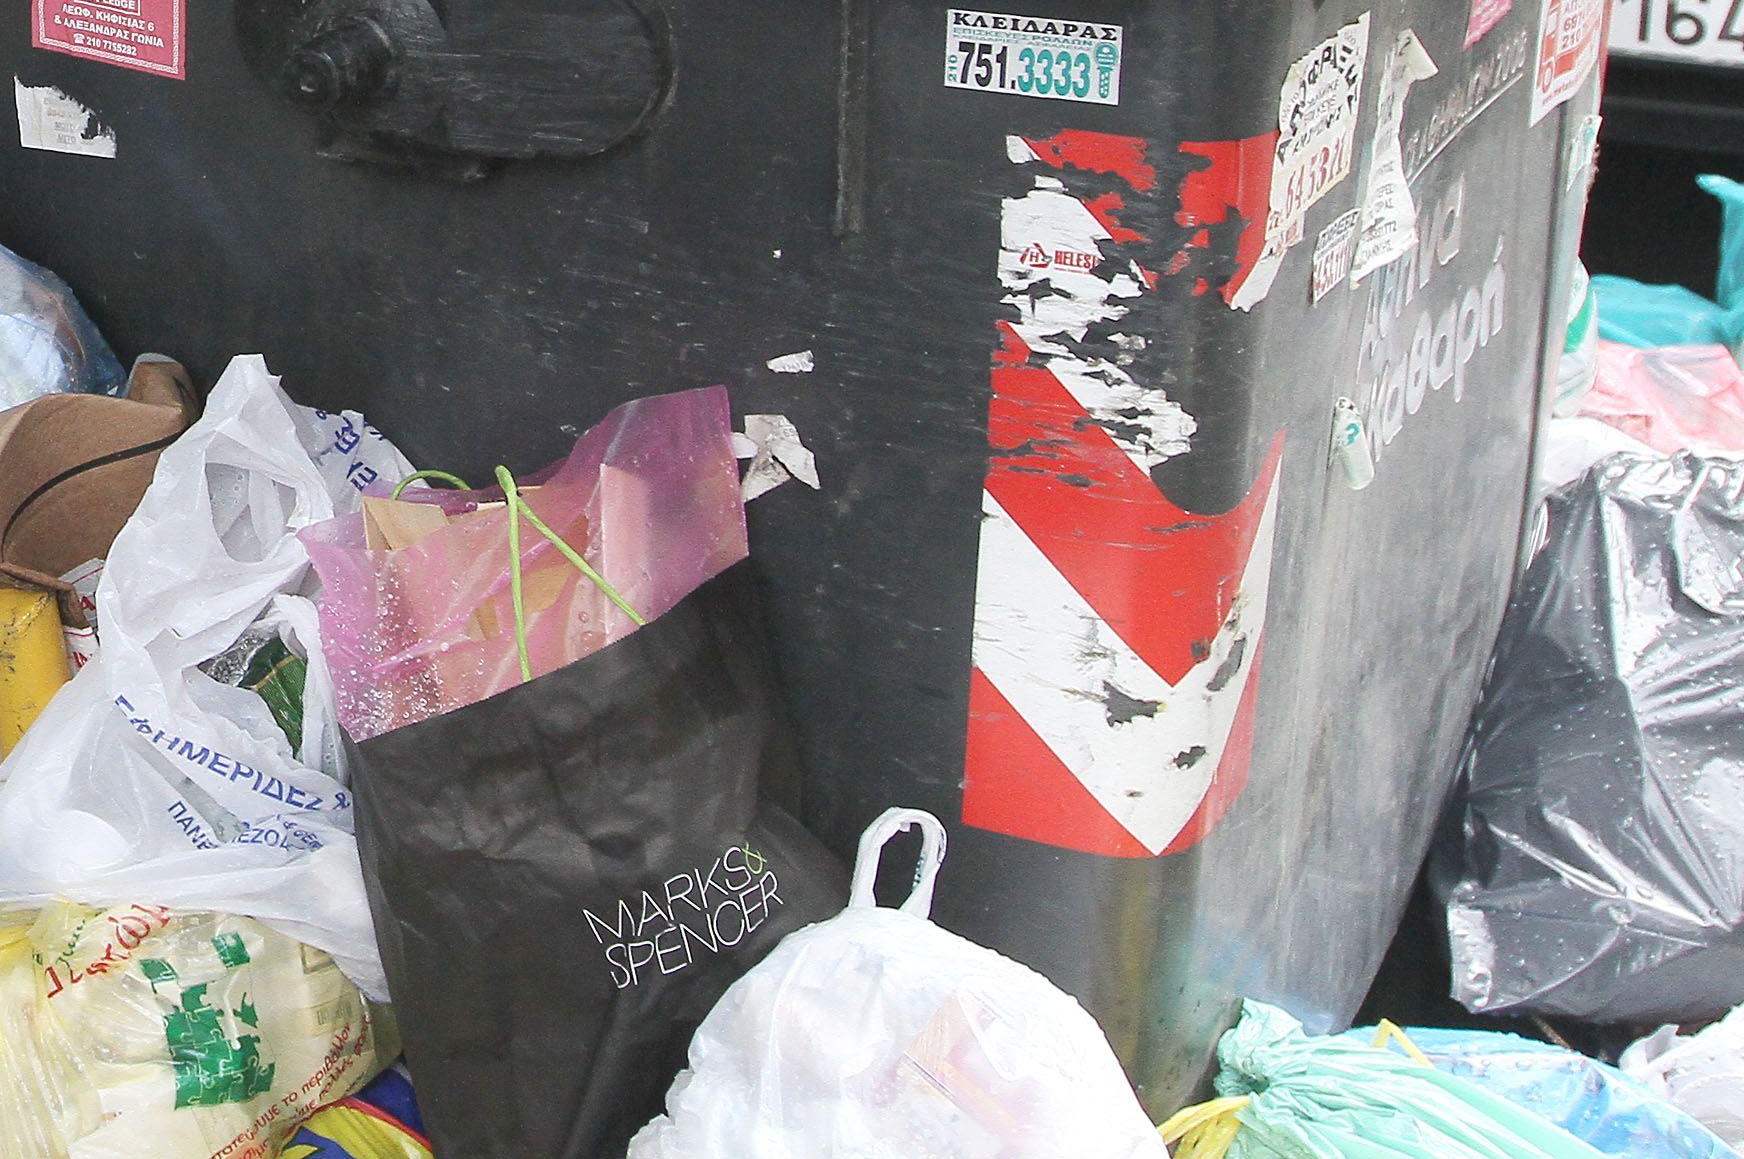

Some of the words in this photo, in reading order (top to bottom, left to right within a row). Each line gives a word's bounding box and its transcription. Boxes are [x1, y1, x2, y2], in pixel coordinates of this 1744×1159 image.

[85, 35, 102, 49] 210
[952, 12, 1119, 42] ΚΛΕΙΔΑΡΑΣ
[947, 54, 958, 83] 210
[957, 41, 1092, 99] 751.3333
[582, 846, 752, 945] MARKS
[741, 841, 768, 875] &
[605, 870, 784, 989] SPENCER
